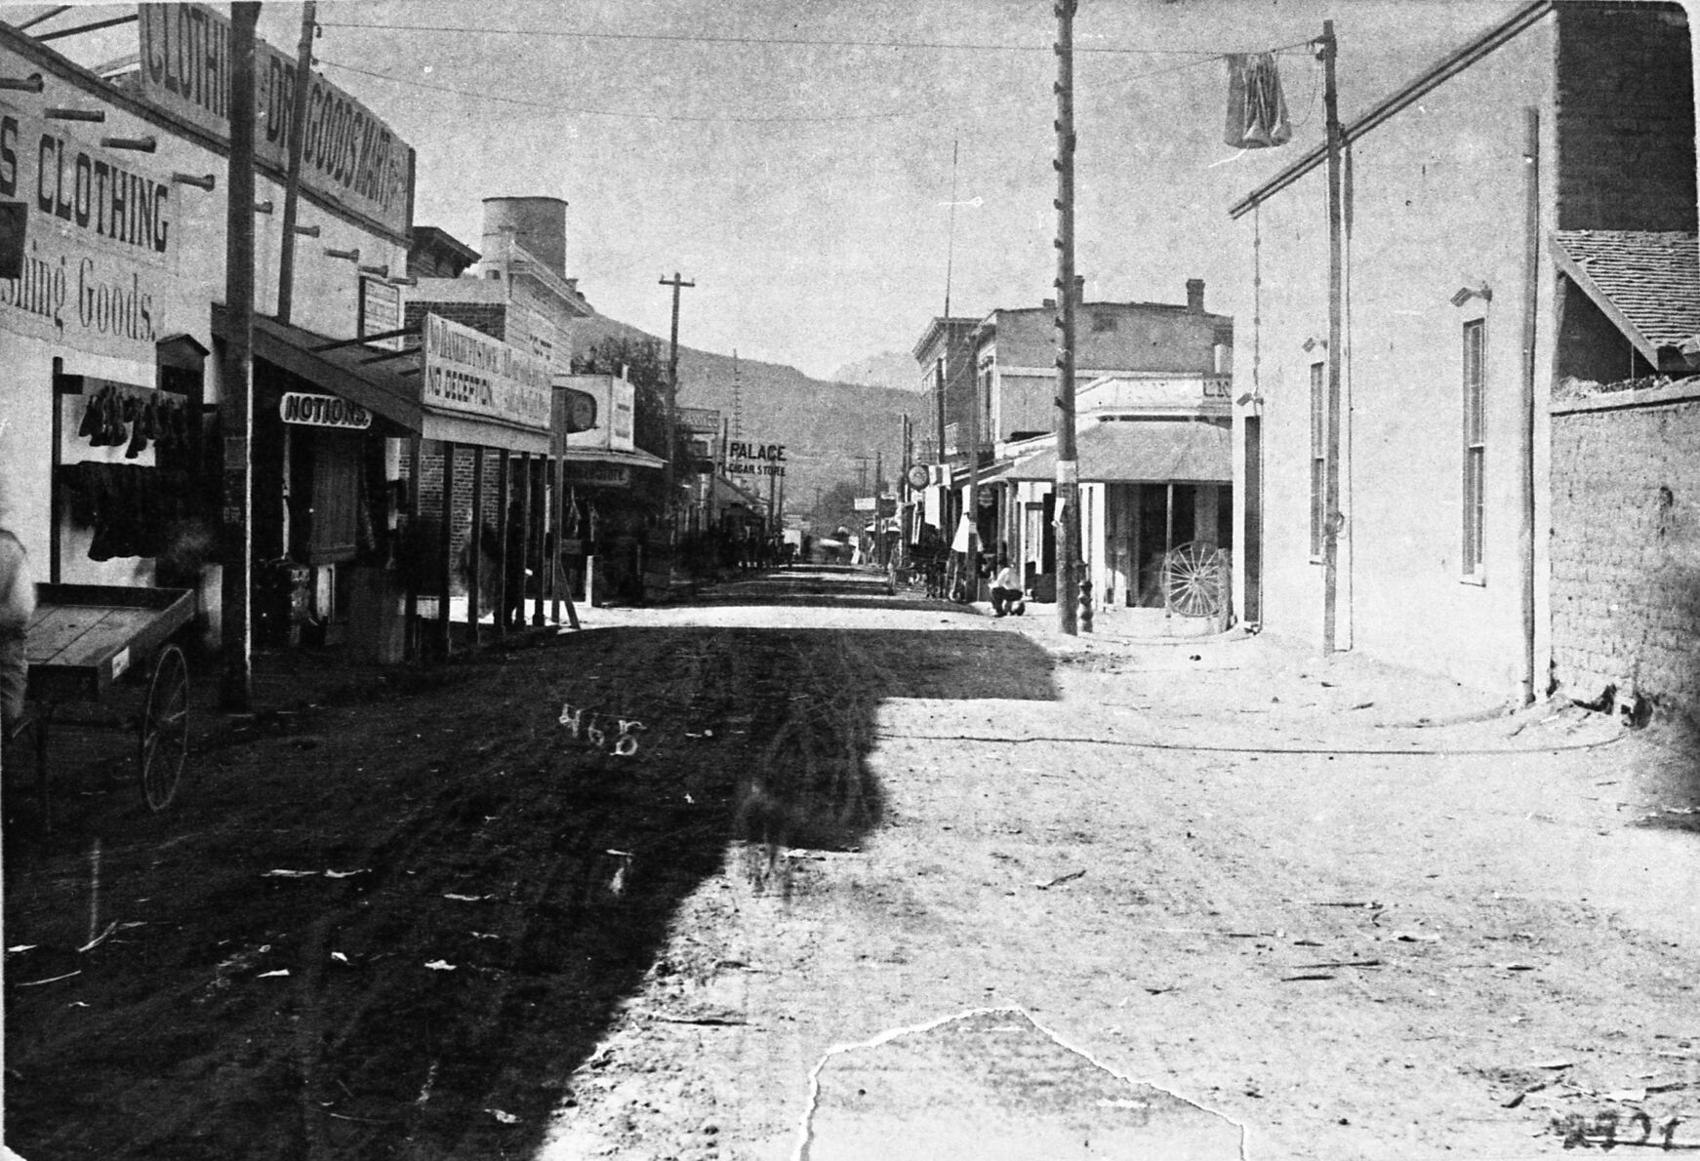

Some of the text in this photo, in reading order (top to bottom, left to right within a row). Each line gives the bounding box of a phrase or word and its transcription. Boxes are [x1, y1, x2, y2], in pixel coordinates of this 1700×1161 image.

[146, 3, 232, 118] CLOTHI
[267, 55, 298, 149] DR
[303, 83, 363, 189] GOODS
[38, 134, 169, 253] CLOTHING
[79, 257, 156, 342] Goods.
[728, 463, 786, 477] CIGAR STORE
[730, 442, 787, 461] PALACE
